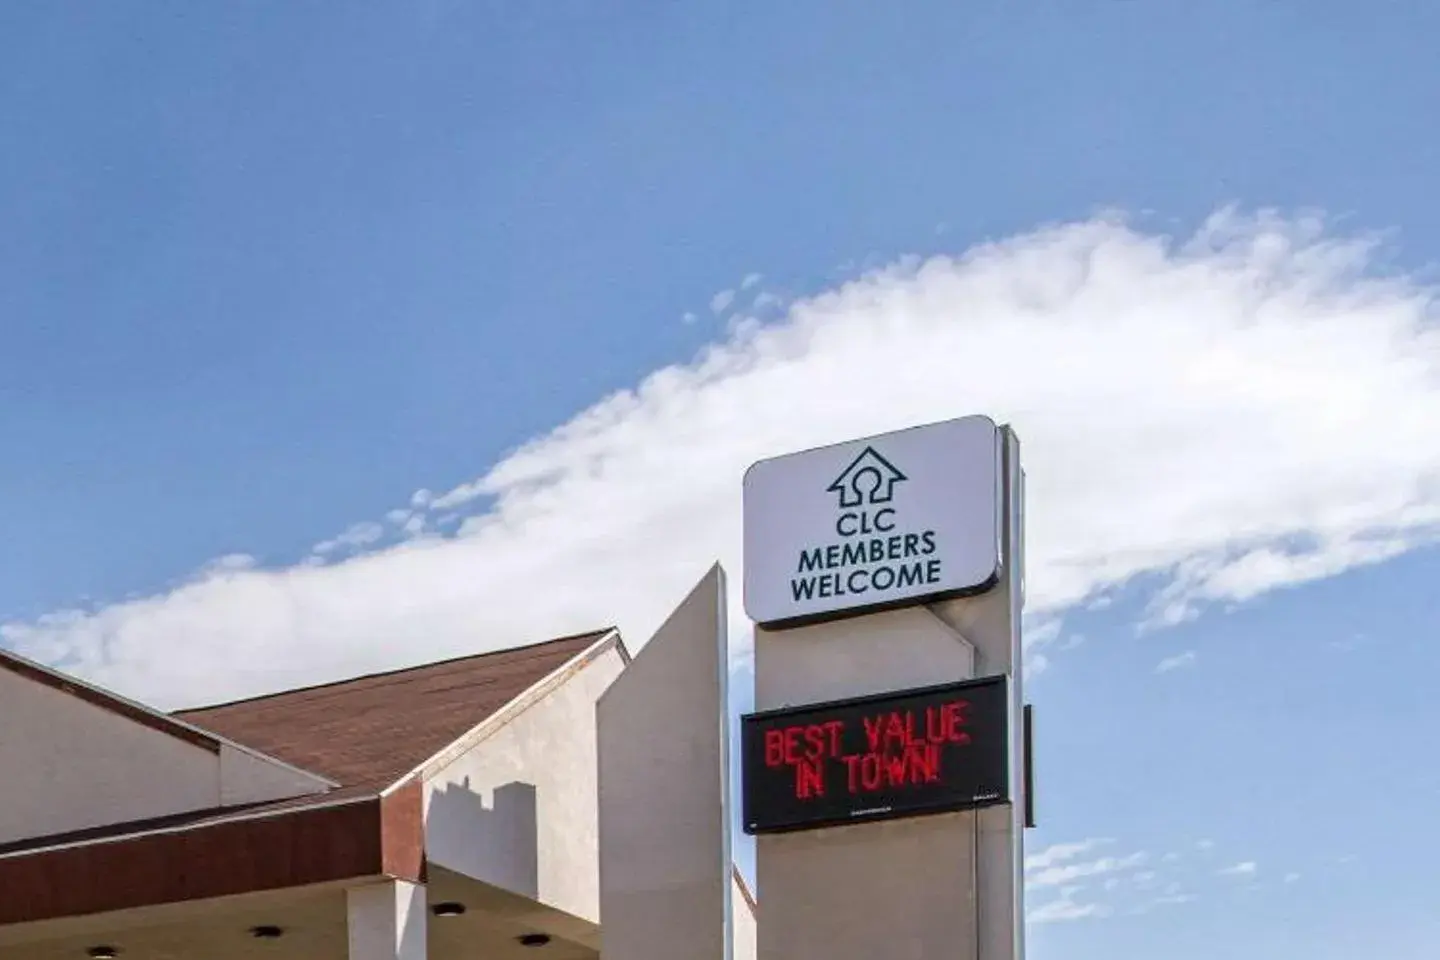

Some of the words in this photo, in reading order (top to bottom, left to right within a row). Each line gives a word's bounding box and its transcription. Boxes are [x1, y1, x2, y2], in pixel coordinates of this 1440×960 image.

[836, 507, 896, 537] CLC
[798, 530, 936, 573] MEMBERS
[791, 559, 941, 601] WELCOME
[764, 720, 844, 767] BEST
[863, 700, 971, 751] VALUE
[795, 756, 824, 799] IN
